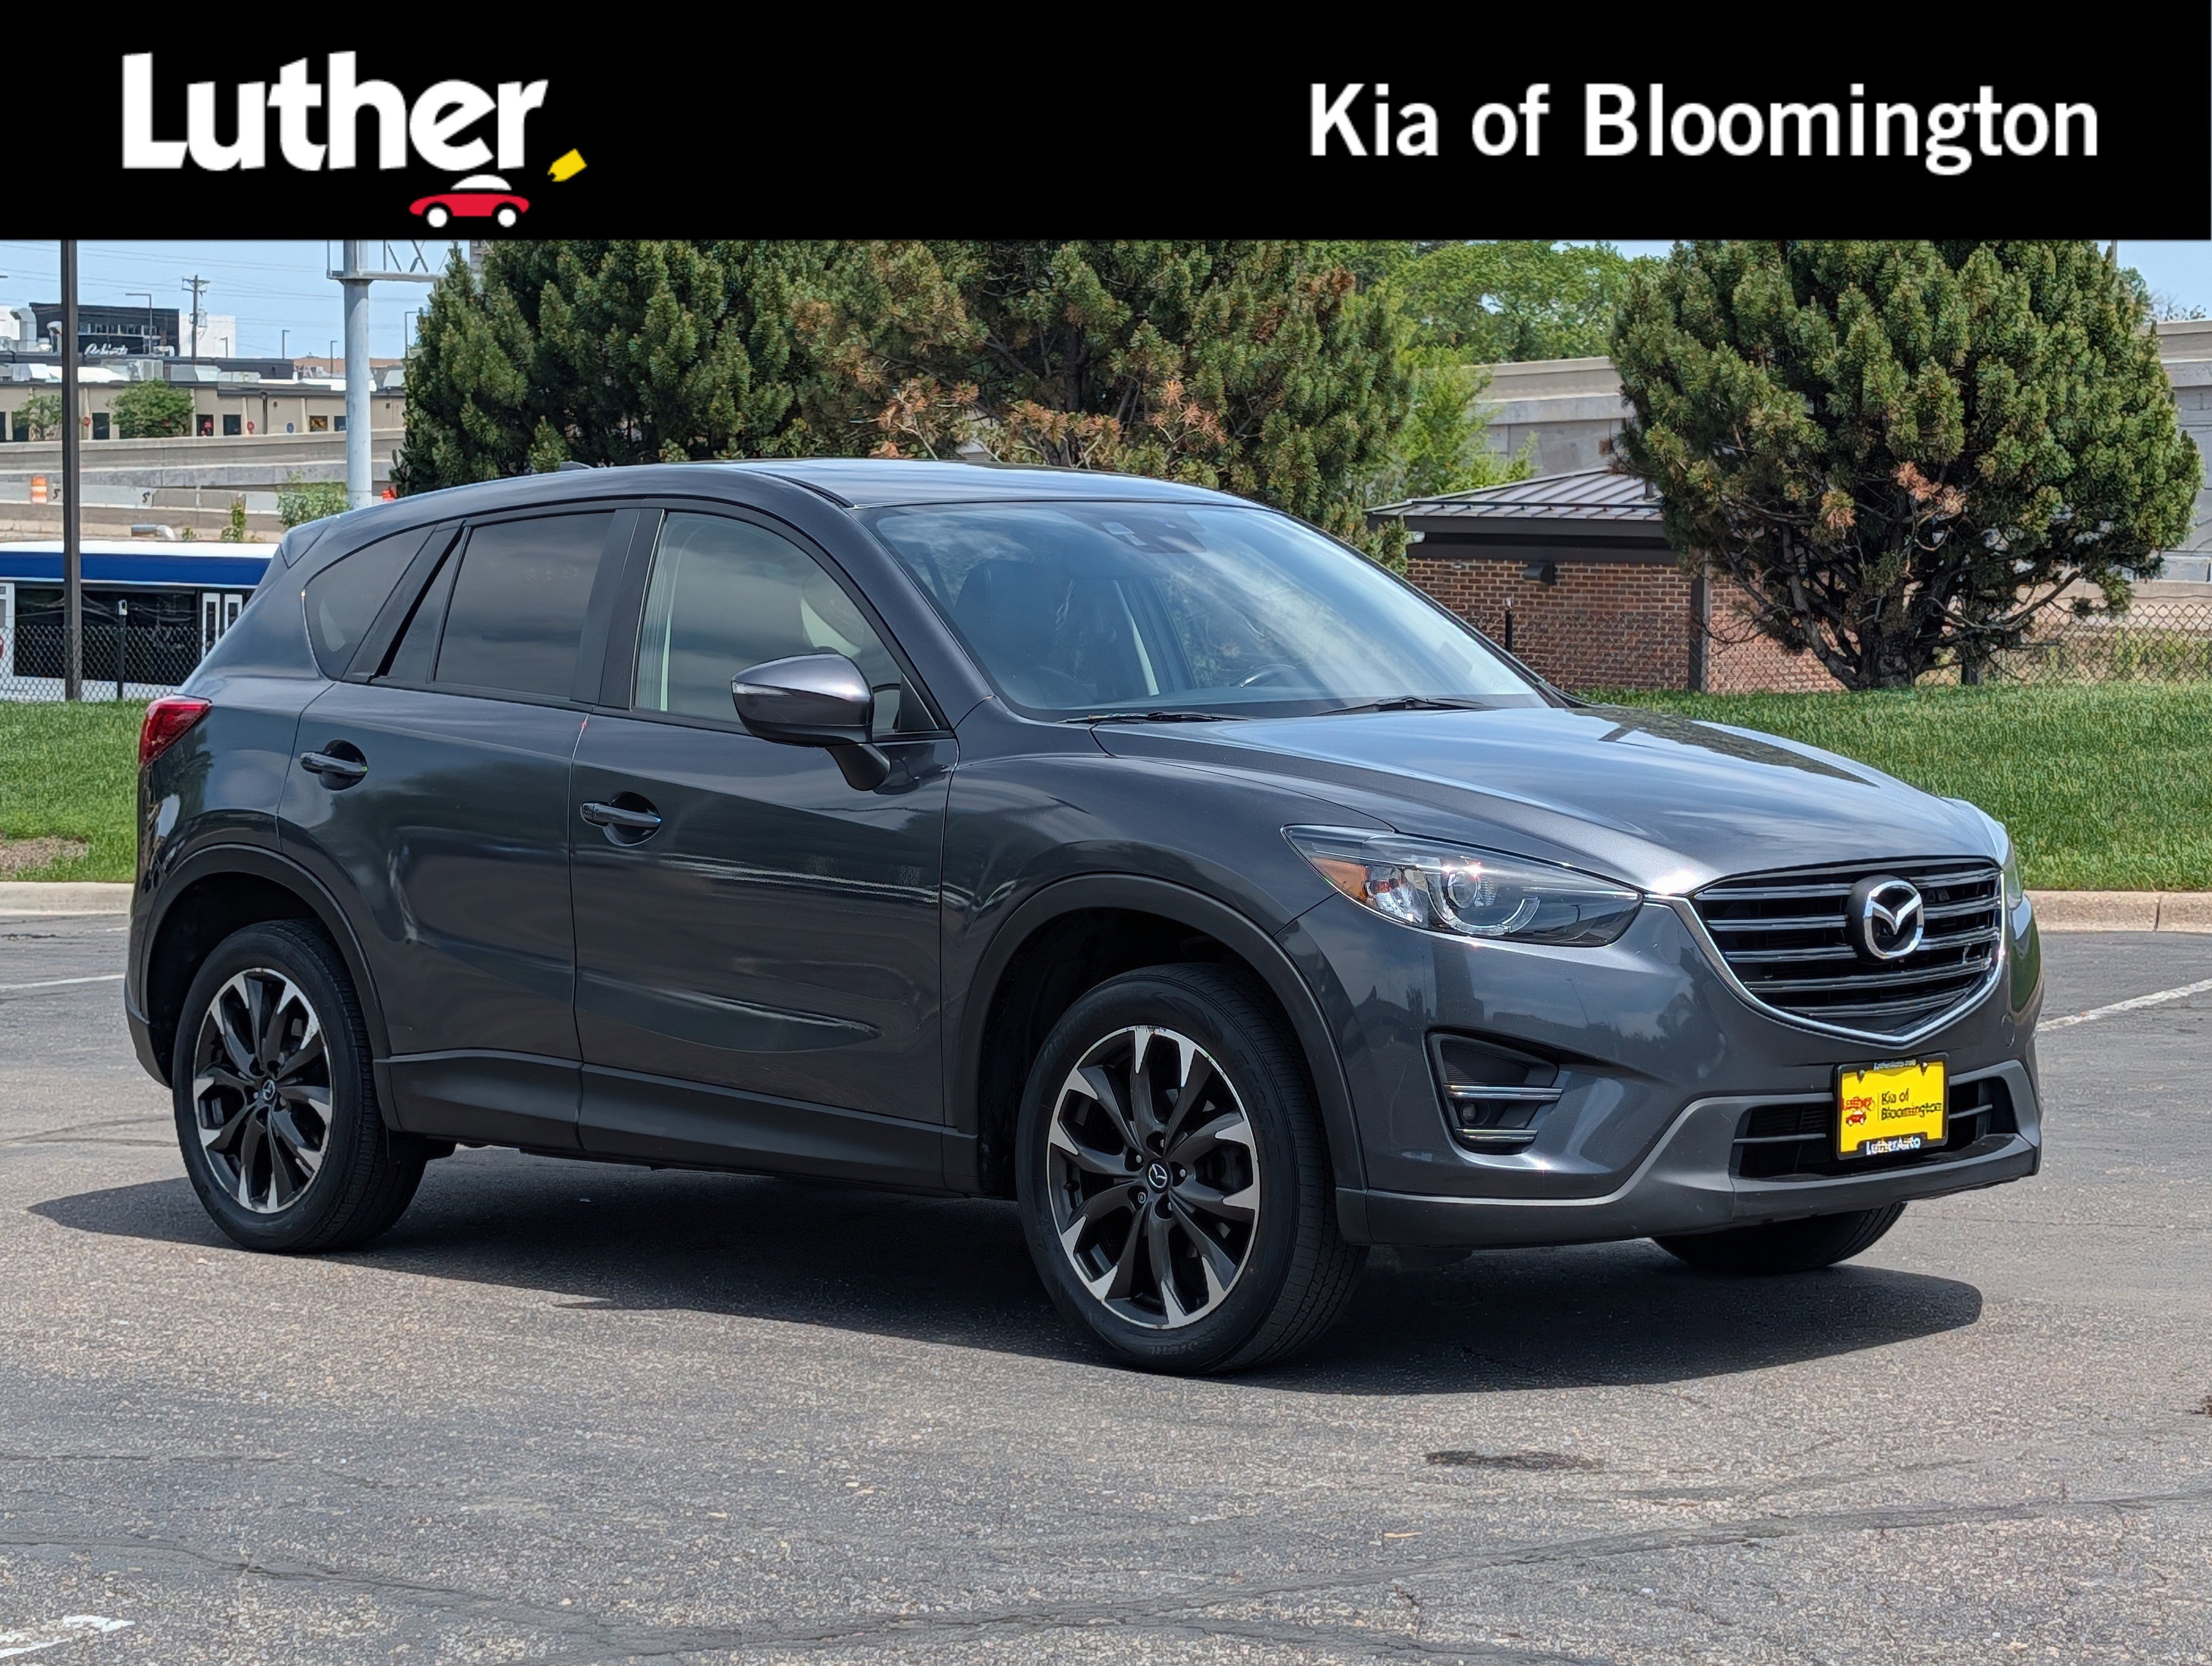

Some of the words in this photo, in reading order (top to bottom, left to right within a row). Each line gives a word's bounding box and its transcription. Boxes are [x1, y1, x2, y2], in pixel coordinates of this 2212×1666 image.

[1881, 1091, 1896, 1105] Kia
[1899, 1088, 1909, 1102] of
[1881, 1102, 1942, 1120] Bloomington
